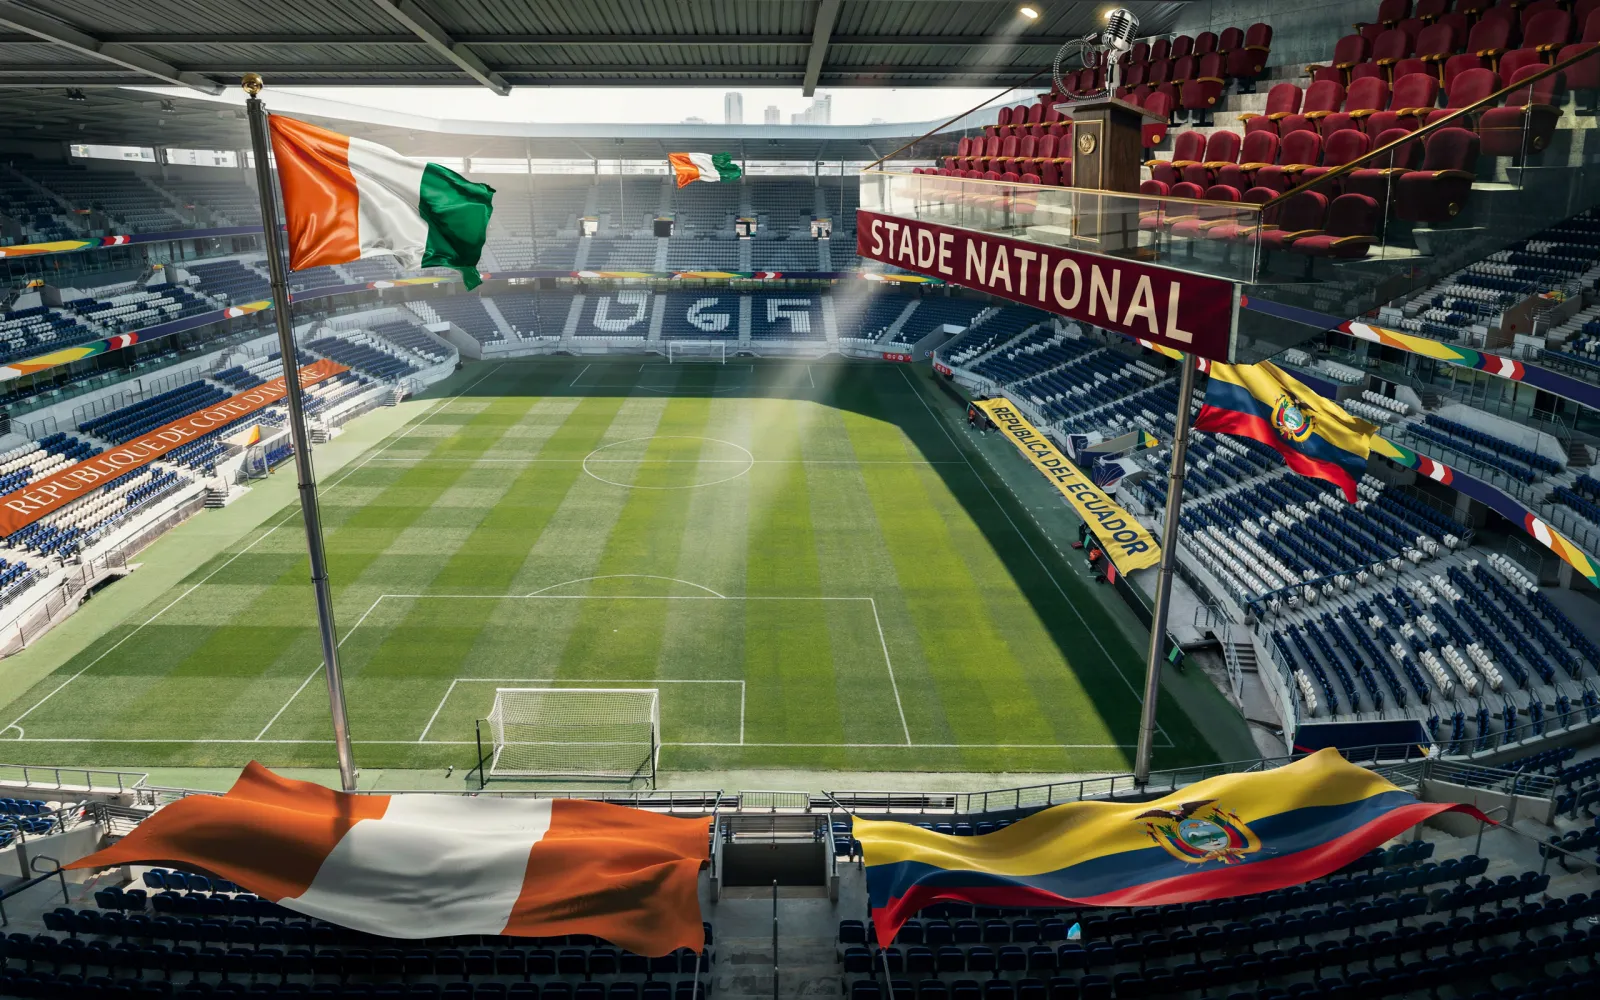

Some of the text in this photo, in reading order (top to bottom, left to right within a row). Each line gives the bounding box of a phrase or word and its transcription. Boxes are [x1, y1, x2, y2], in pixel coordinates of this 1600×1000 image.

[871, 219, 1194, 344] STADE NATIONAL
[4, 368, 325, 515] RÉPUBLIQUE DE CÔTE D'IVORE
[991, 406, 1149, 556] REPUBLICA DEL ECUADOR
